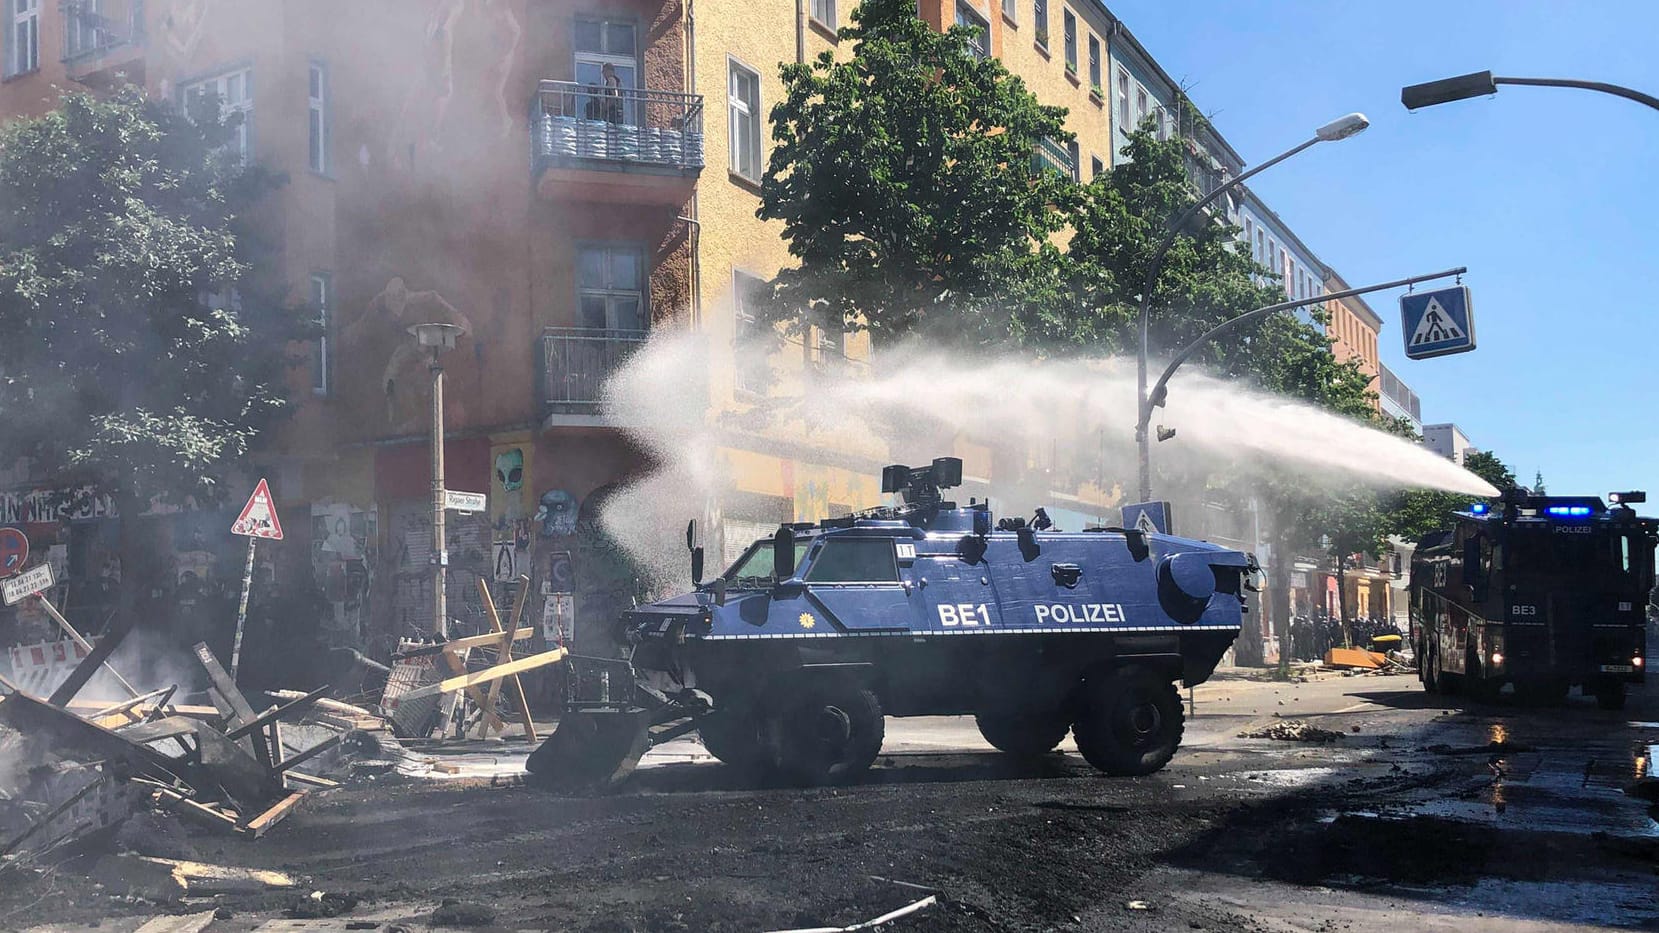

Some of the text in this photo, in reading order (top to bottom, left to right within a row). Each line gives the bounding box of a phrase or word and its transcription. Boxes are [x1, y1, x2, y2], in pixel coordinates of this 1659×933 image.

[1555, 525, 1591, 534] POLIZEI
[937, 604, 992, 626] BE1
[1034, 604, 1126, 624] POLIZEI
[1512, 605, 1536, 615] BE3
